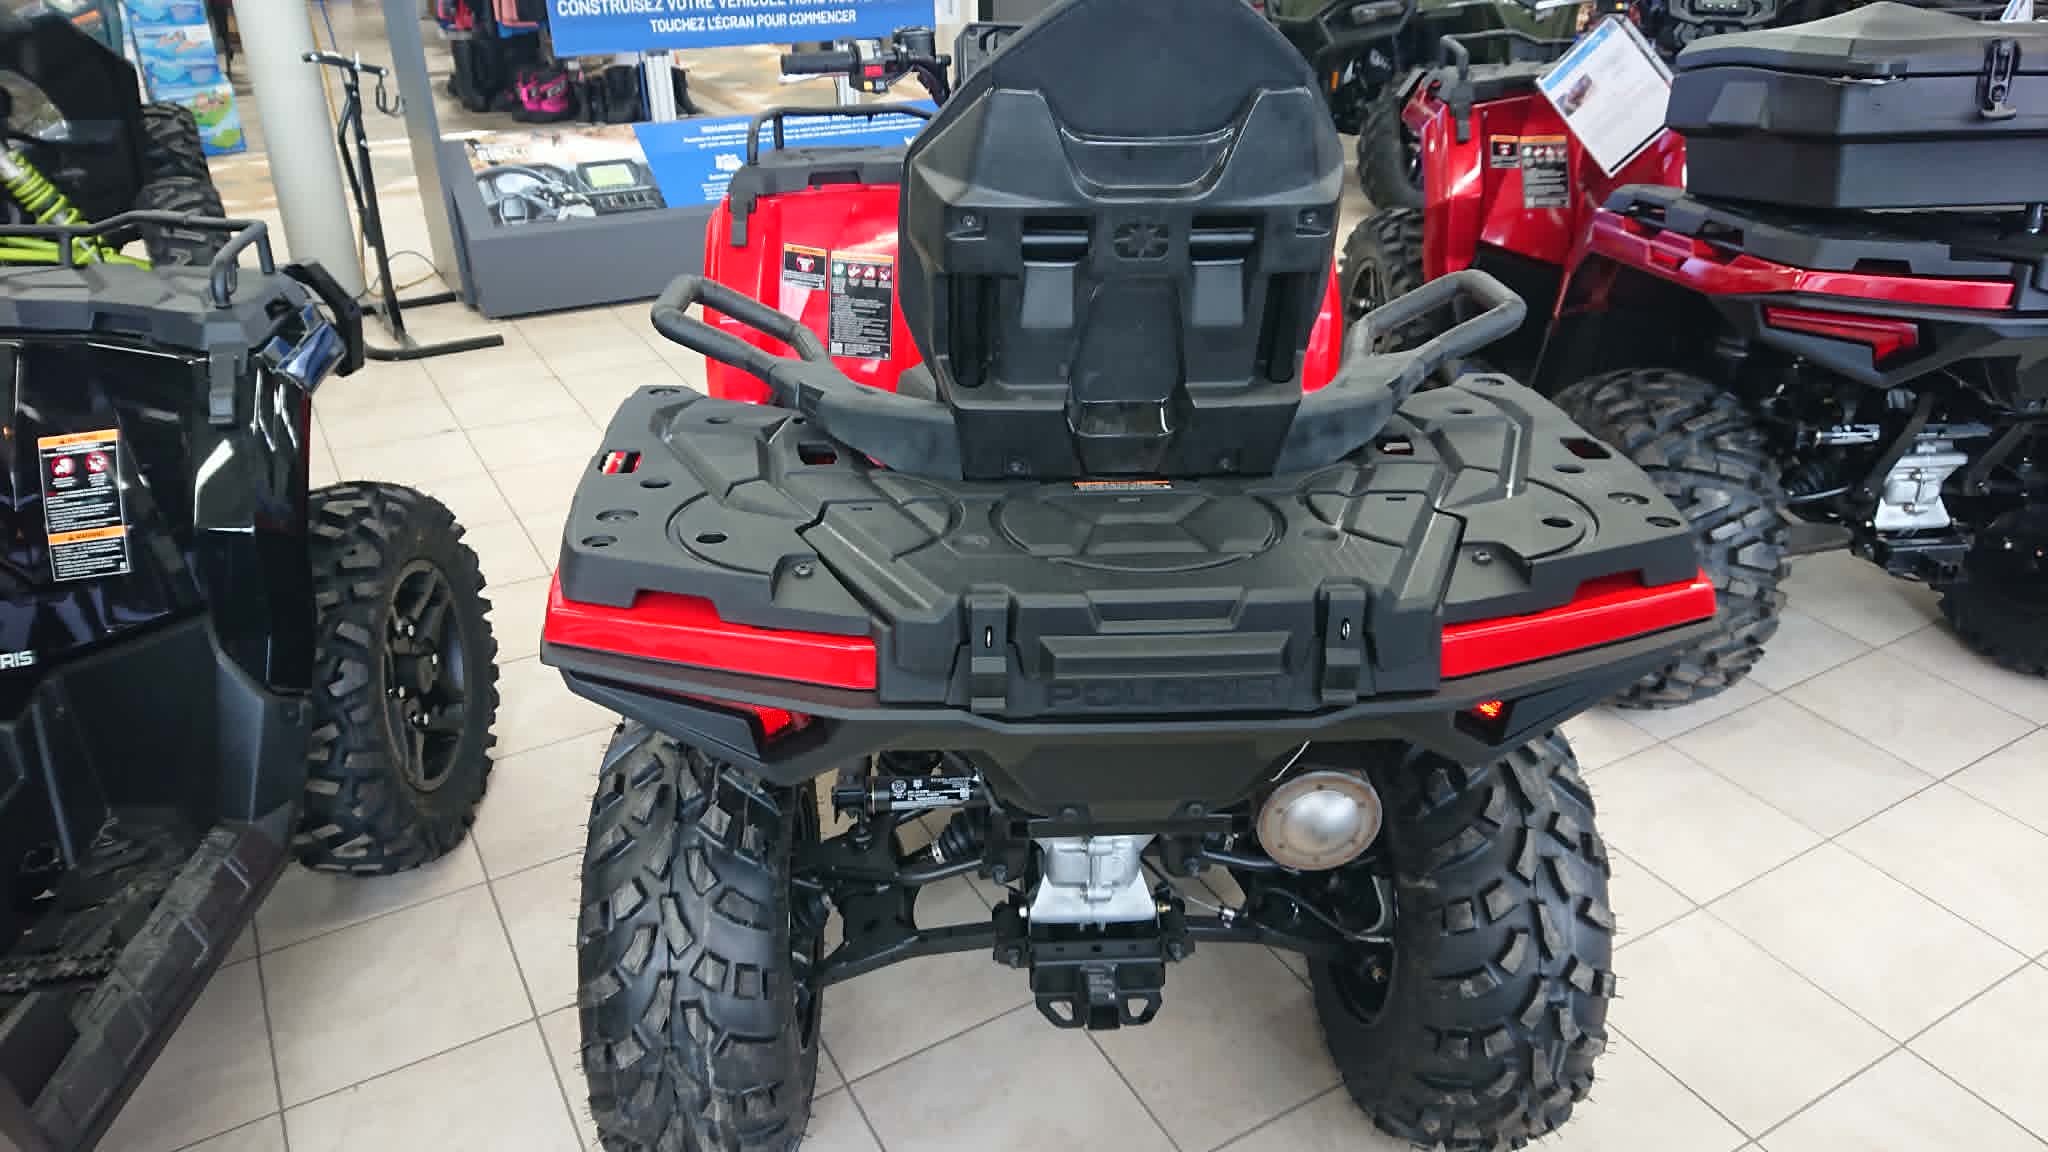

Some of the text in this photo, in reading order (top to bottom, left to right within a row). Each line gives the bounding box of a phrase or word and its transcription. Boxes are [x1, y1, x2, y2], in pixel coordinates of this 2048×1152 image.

[557, 0, 664, 16] CONSTRUISEZ
[651, 18, 706, 33] TOUCHEZ
[757, 12, 787, 28] POUR
[790, 9, 857, 25] COMMENCER
